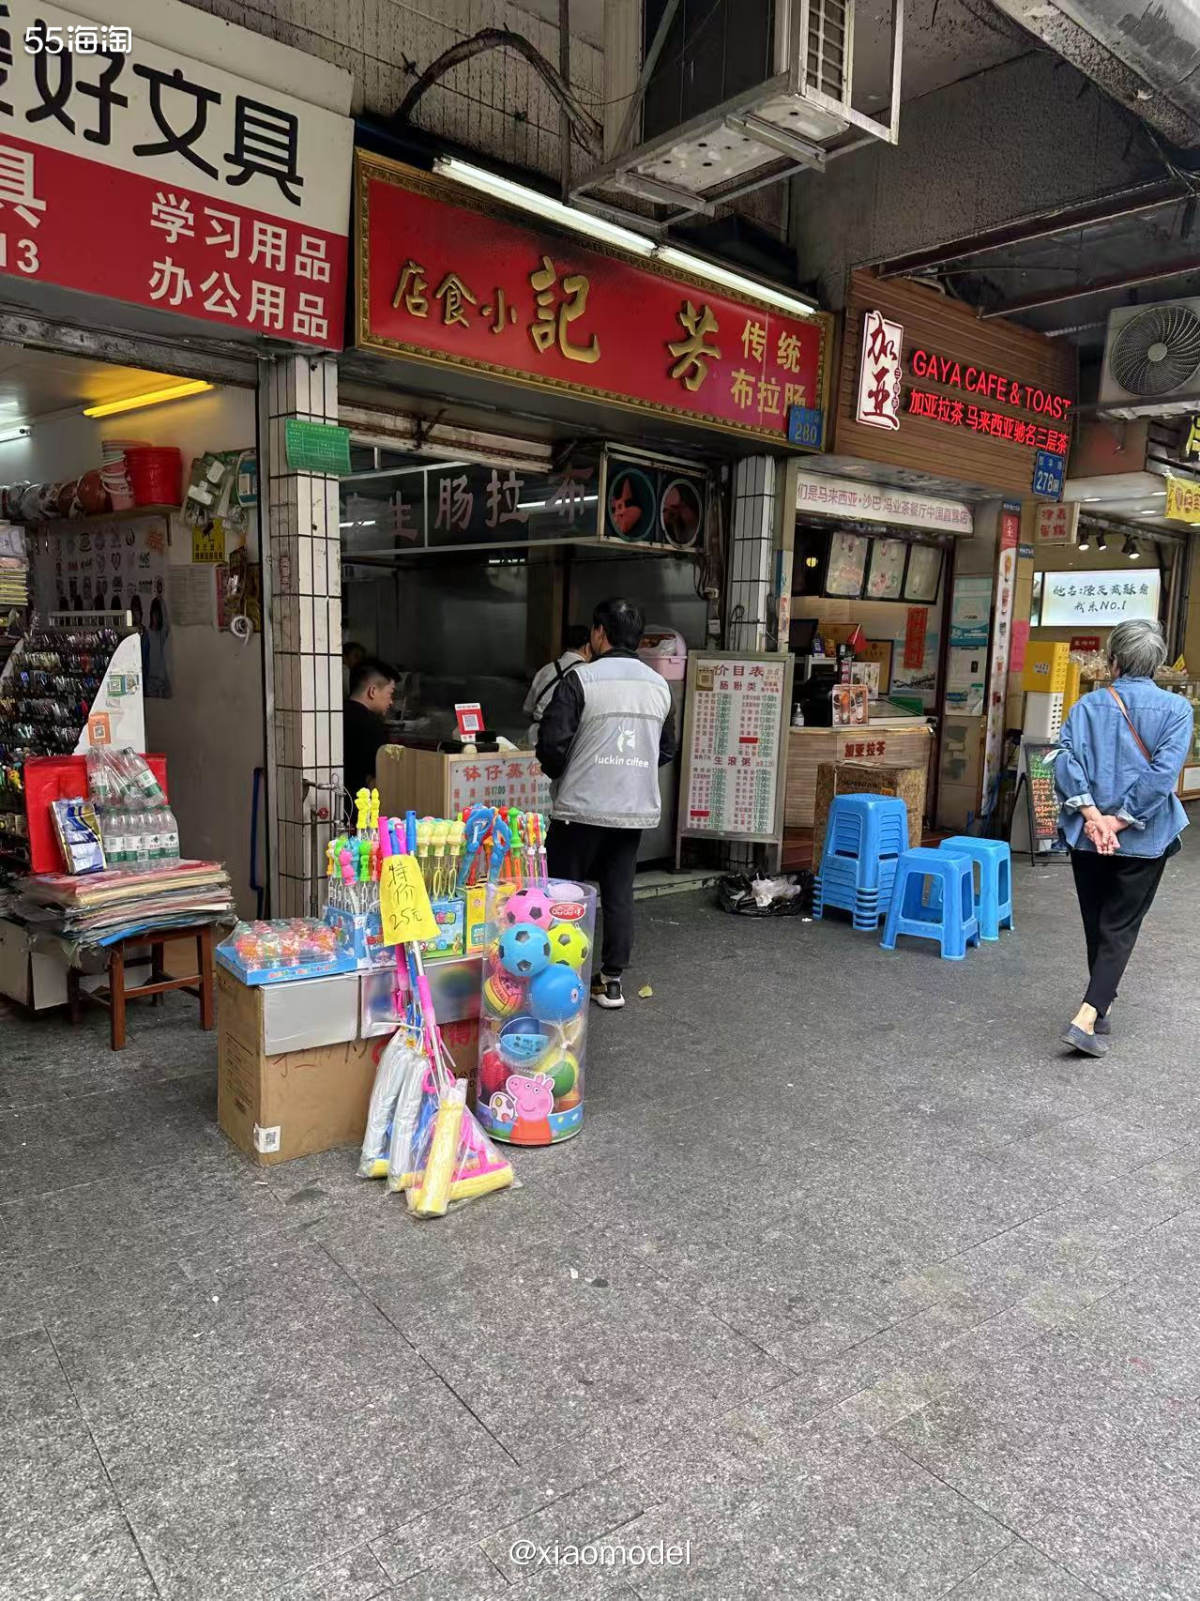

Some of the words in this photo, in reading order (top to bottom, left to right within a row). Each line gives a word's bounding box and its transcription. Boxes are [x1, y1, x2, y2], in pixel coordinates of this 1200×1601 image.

[0, 4, 304, 207] 好文具
[151, 192, 330, 283] 学习用品
[150, 257, 328, 339] 办公用品
[741, 320, 802, 373] 传统
[909, 391, 964, 426] 加亚拉茶
[913, 350, 961, 390] GAYA
[965, 367, 1007, 402] CAFE
[1010, 382, 1020, 405] &
[1025, 386, 1071, 421] TOAST
[795, 424, 817, 443] 280
